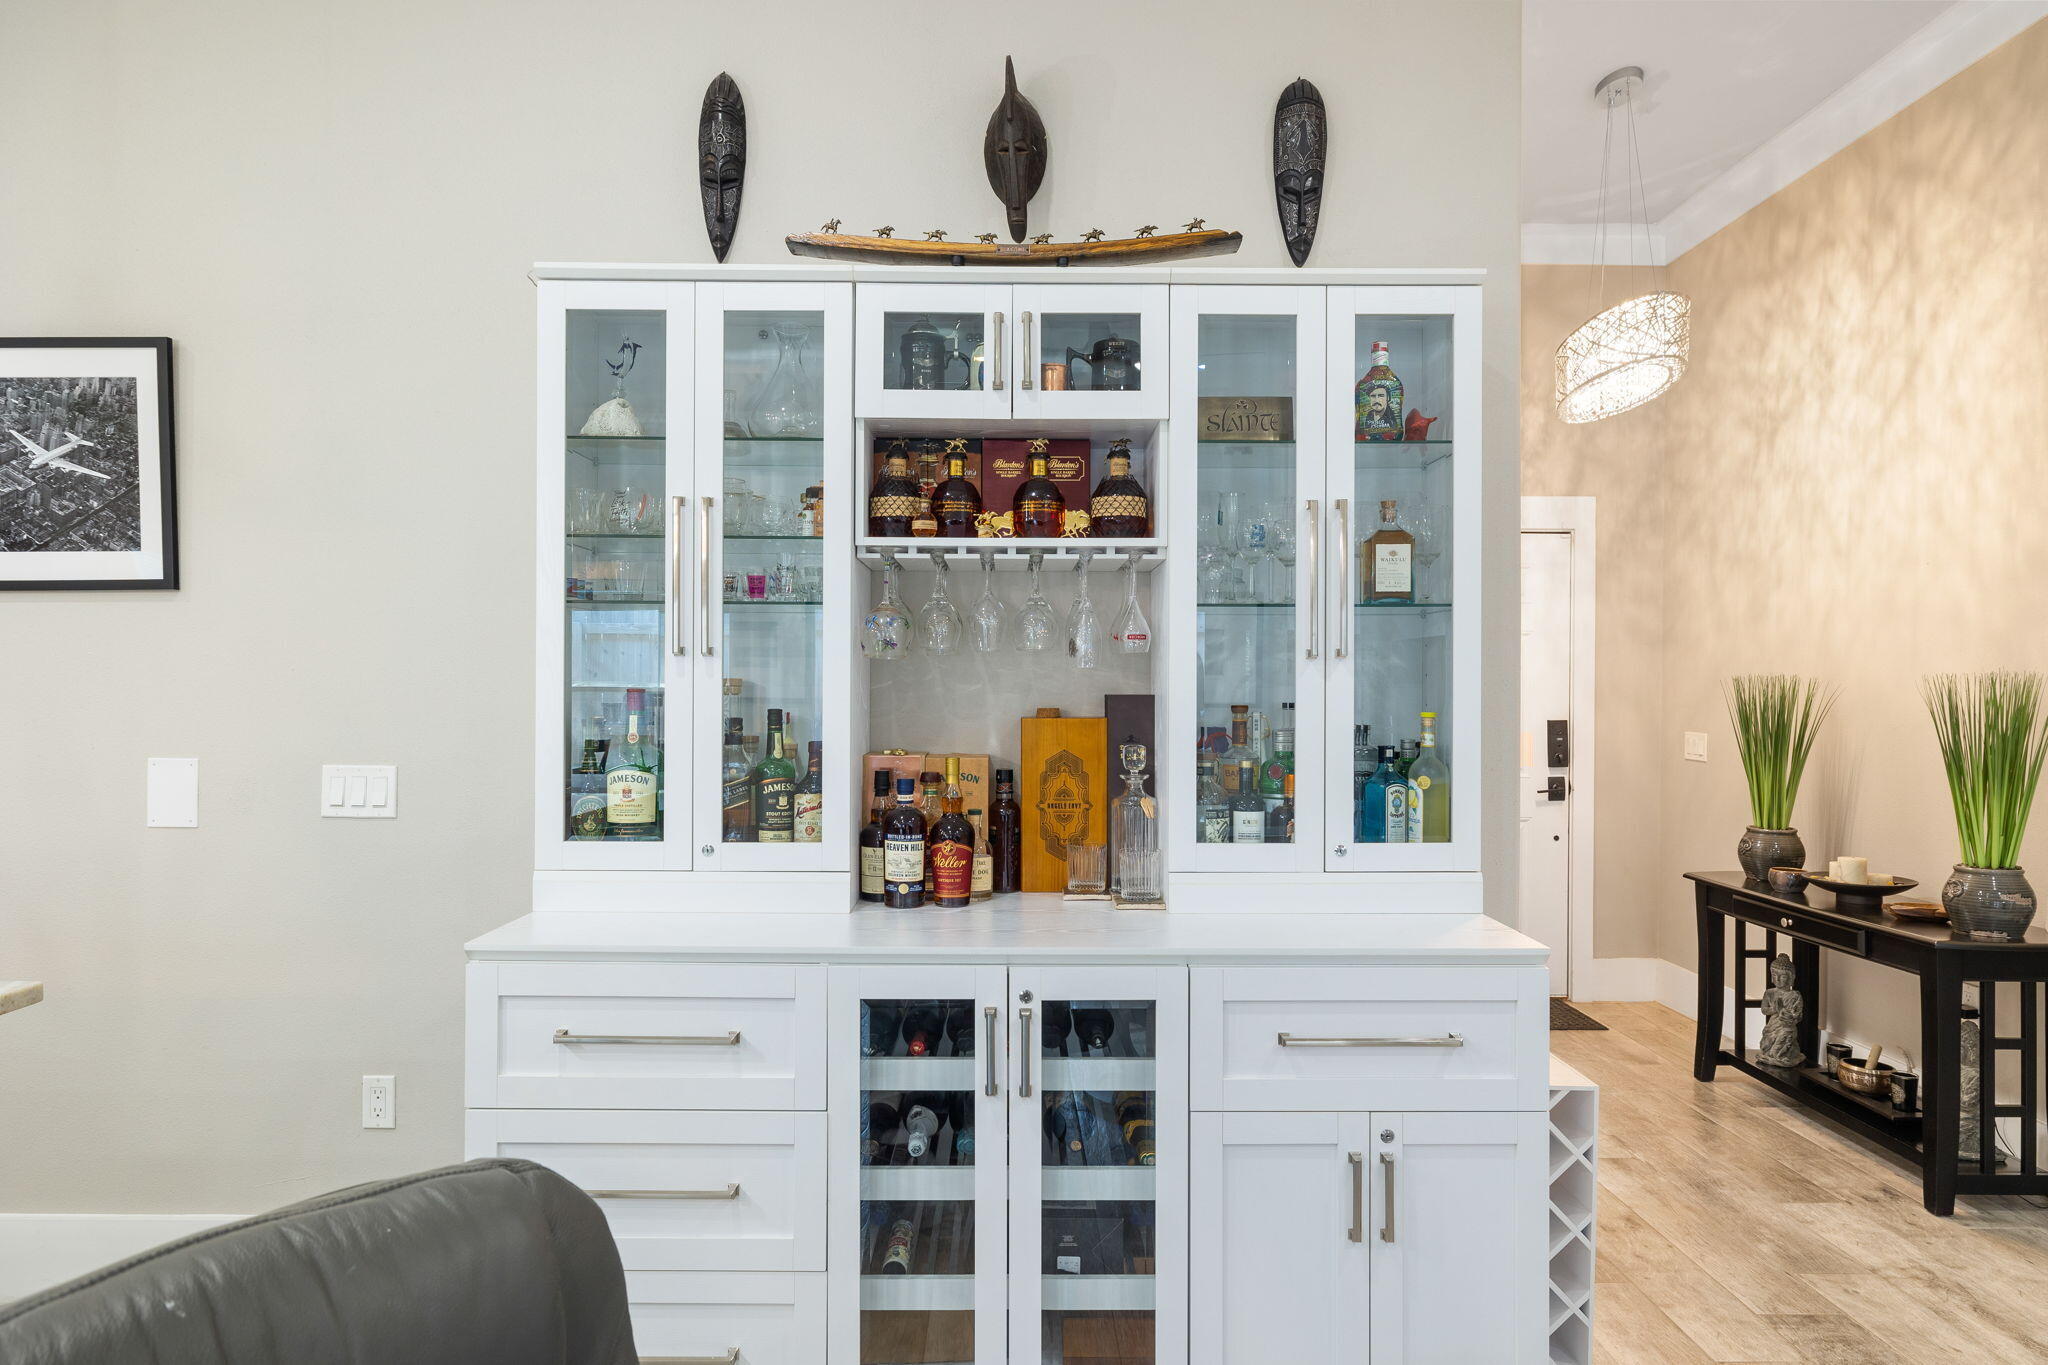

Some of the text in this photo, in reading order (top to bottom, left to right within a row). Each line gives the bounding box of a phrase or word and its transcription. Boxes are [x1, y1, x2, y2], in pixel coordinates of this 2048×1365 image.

[993, 458, 1025, 469] Blanton's
[1047, 458, 1080, 469] Blanton's
[609, 774, 650, 786] JAMESON
[886, 842, 924, 852] HEAVEN HILL
[933, 852, 967, 868] Weller
